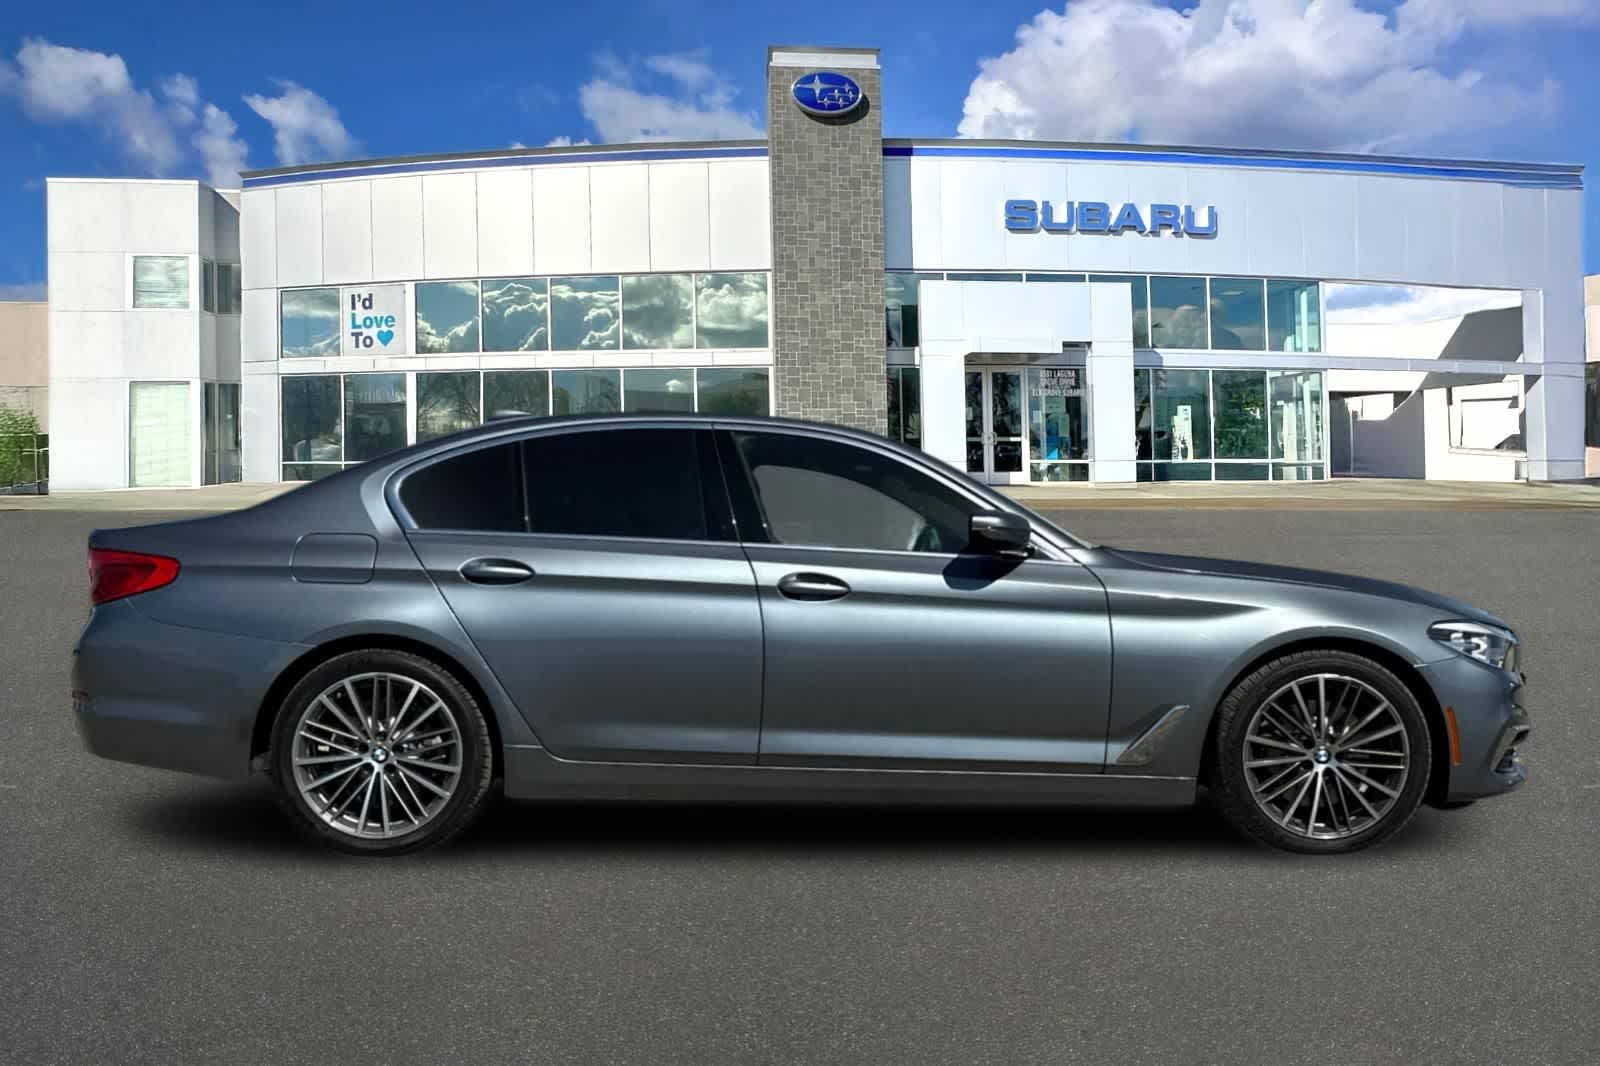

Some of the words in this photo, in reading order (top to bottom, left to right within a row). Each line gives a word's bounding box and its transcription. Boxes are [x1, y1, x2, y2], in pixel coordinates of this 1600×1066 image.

[1005, 199, 1217, 238] SUBARU
[351, 293, 373, 310] I'd
[351, 312, 396, 329] Love
[351, 332, 374, 349] To
